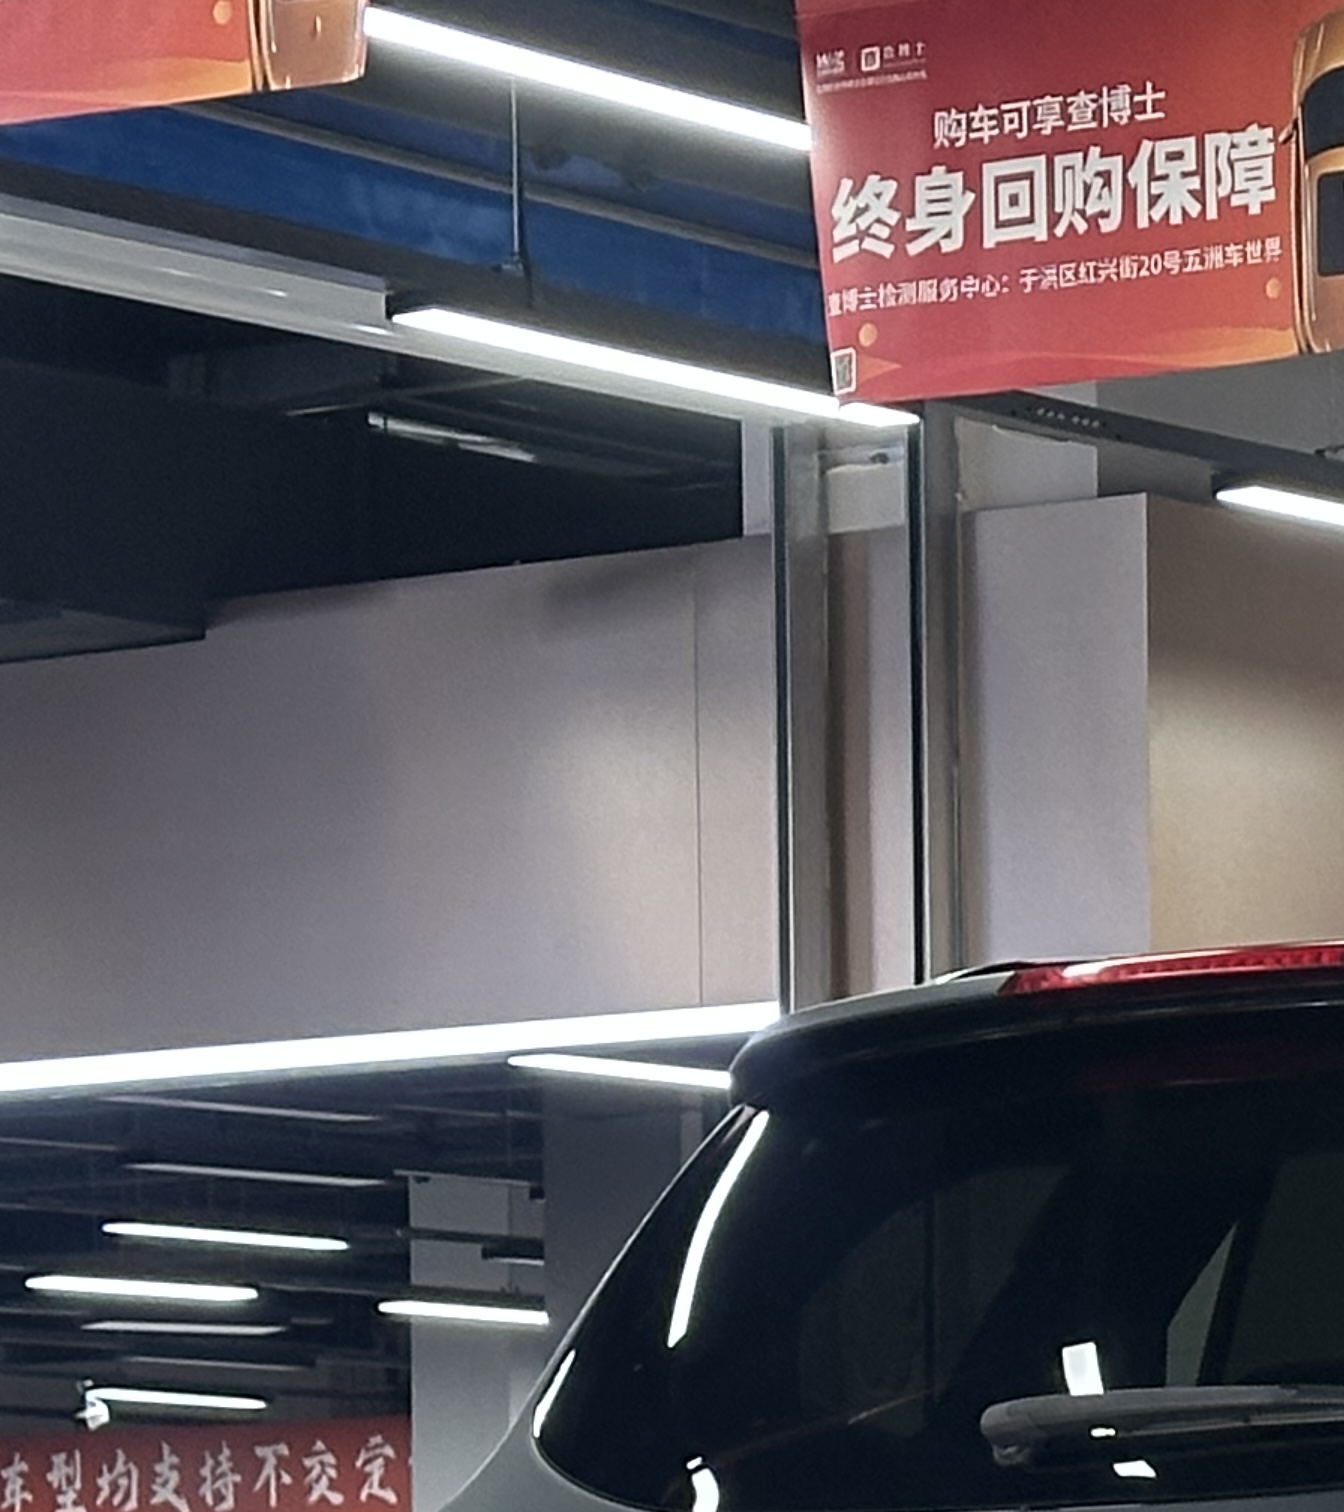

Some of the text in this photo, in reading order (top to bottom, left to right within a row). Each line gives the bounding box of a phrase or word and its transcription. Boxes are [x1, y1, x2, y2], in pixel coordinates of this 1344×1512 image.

[933, 82, 1166, 149] 购车可享查博士
[831, 122, 1276, 263] 终身回购保障
